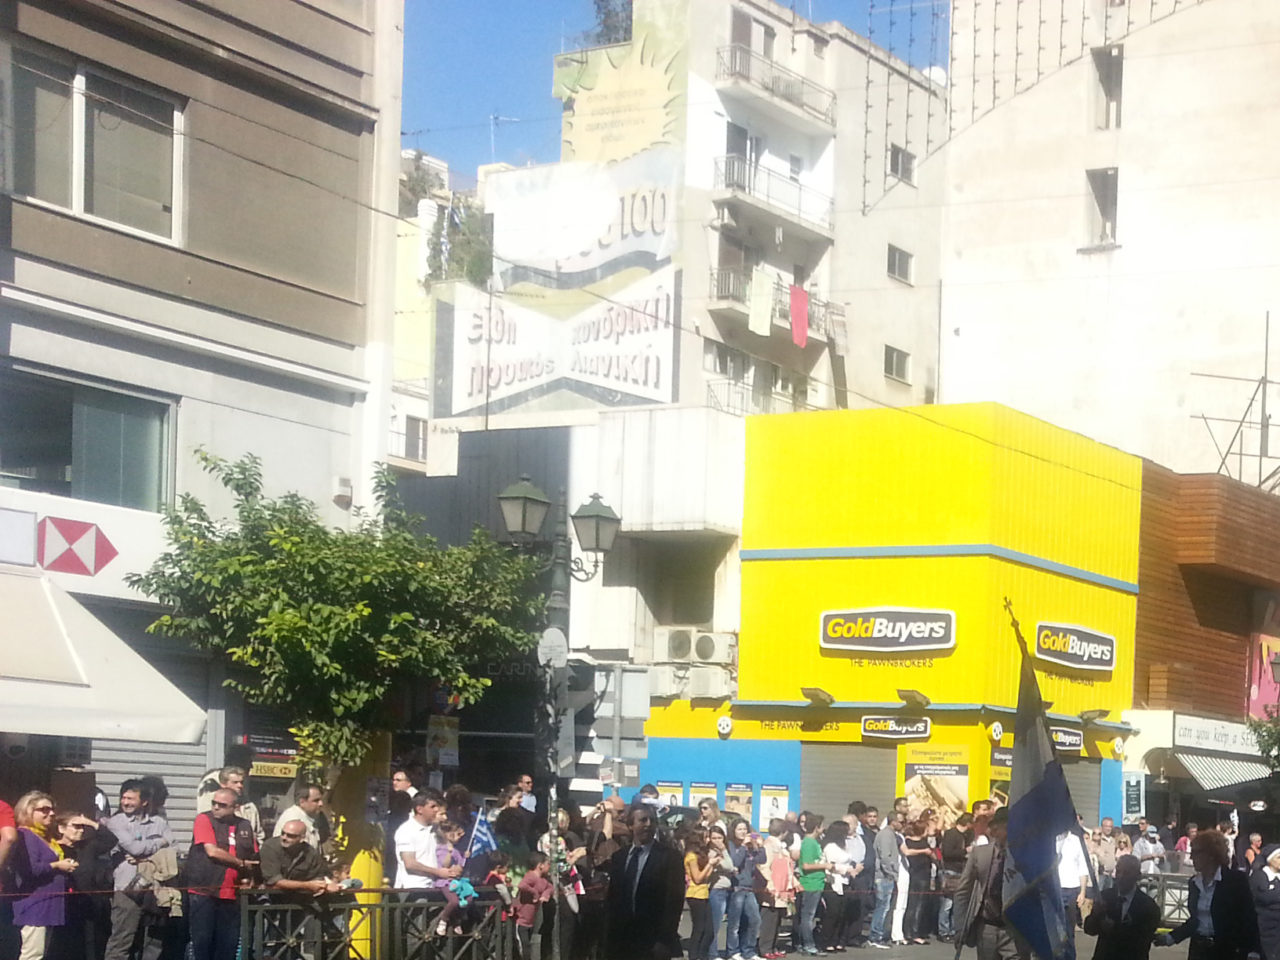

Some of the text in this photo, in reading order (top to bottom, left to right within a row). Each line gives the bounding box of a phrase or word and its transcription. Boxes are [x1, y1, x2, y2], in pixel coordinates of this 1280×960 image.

[826, 617, 946, 643] GoldBuyers
[1039, 629, 1112, 661] GoldBuyers
[851, 658, 934, 668] THE PAWNBROKERS
[865, 719, 926, 734] GoldBuyers
[255, 764, 278, 776] HSBC
